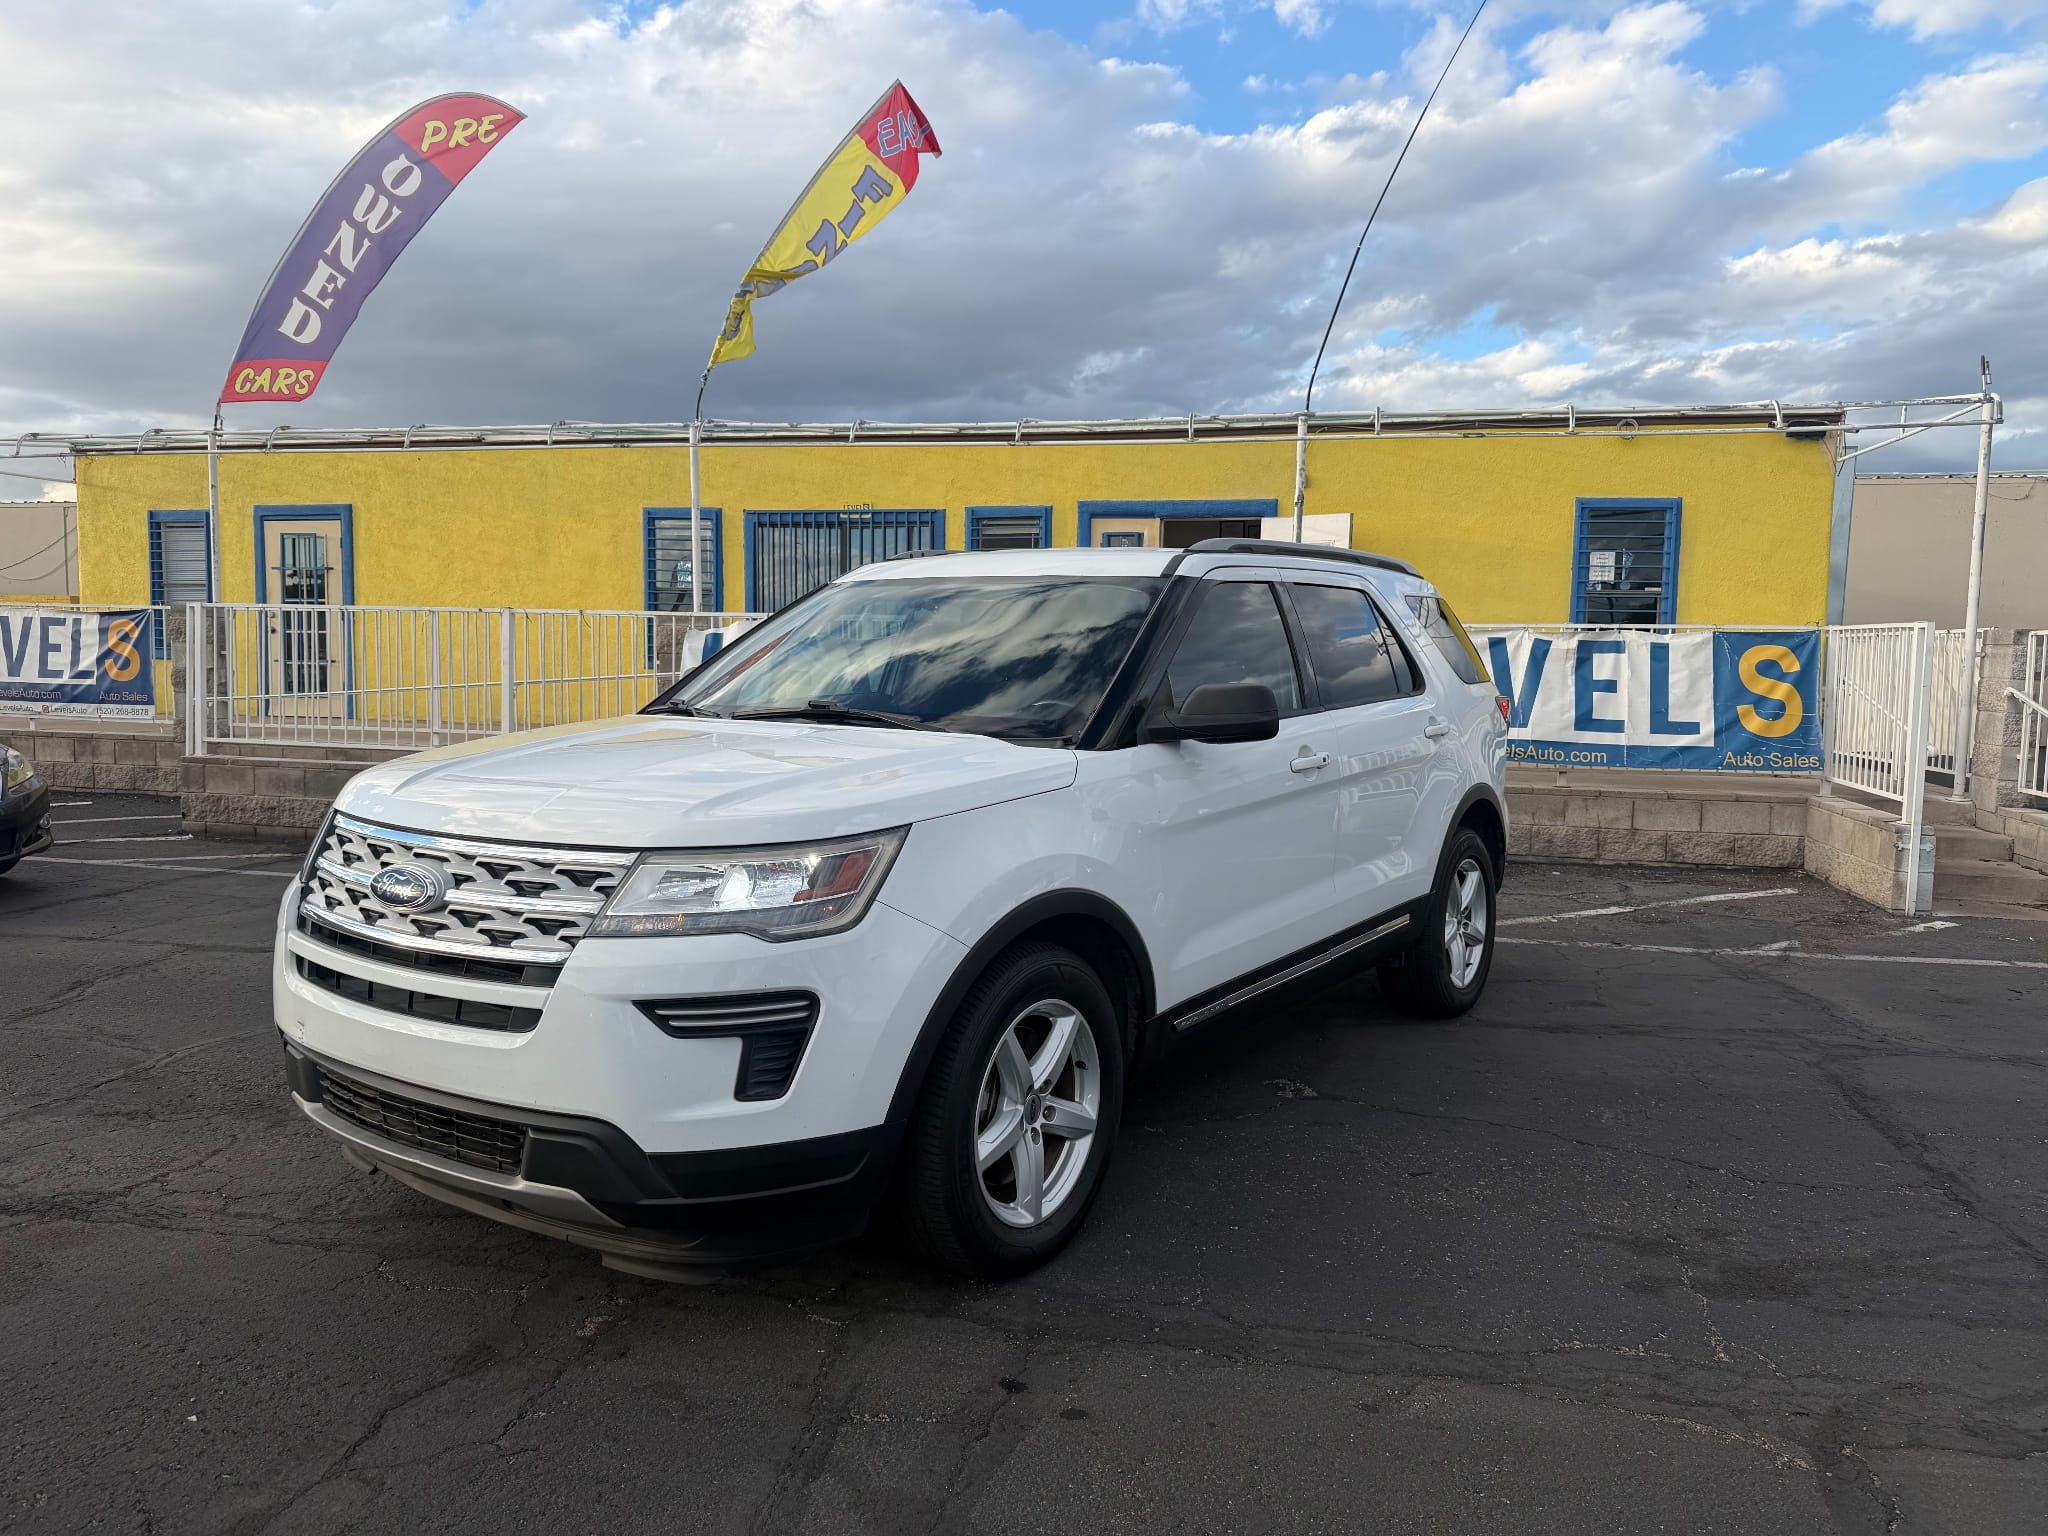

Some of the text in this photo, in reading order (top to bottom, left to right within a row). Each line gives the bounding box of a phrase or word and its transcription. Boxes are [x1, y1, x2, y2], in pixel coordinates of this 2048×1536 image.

[421, 114, 504, 152] PRE
[277, 153, 422, 344] OWNED
[234, 367, 315, 395] CARS
[99, 690, 148, 702] Auto Sales
[1722, 751, 1820, 768] Auto Sales
